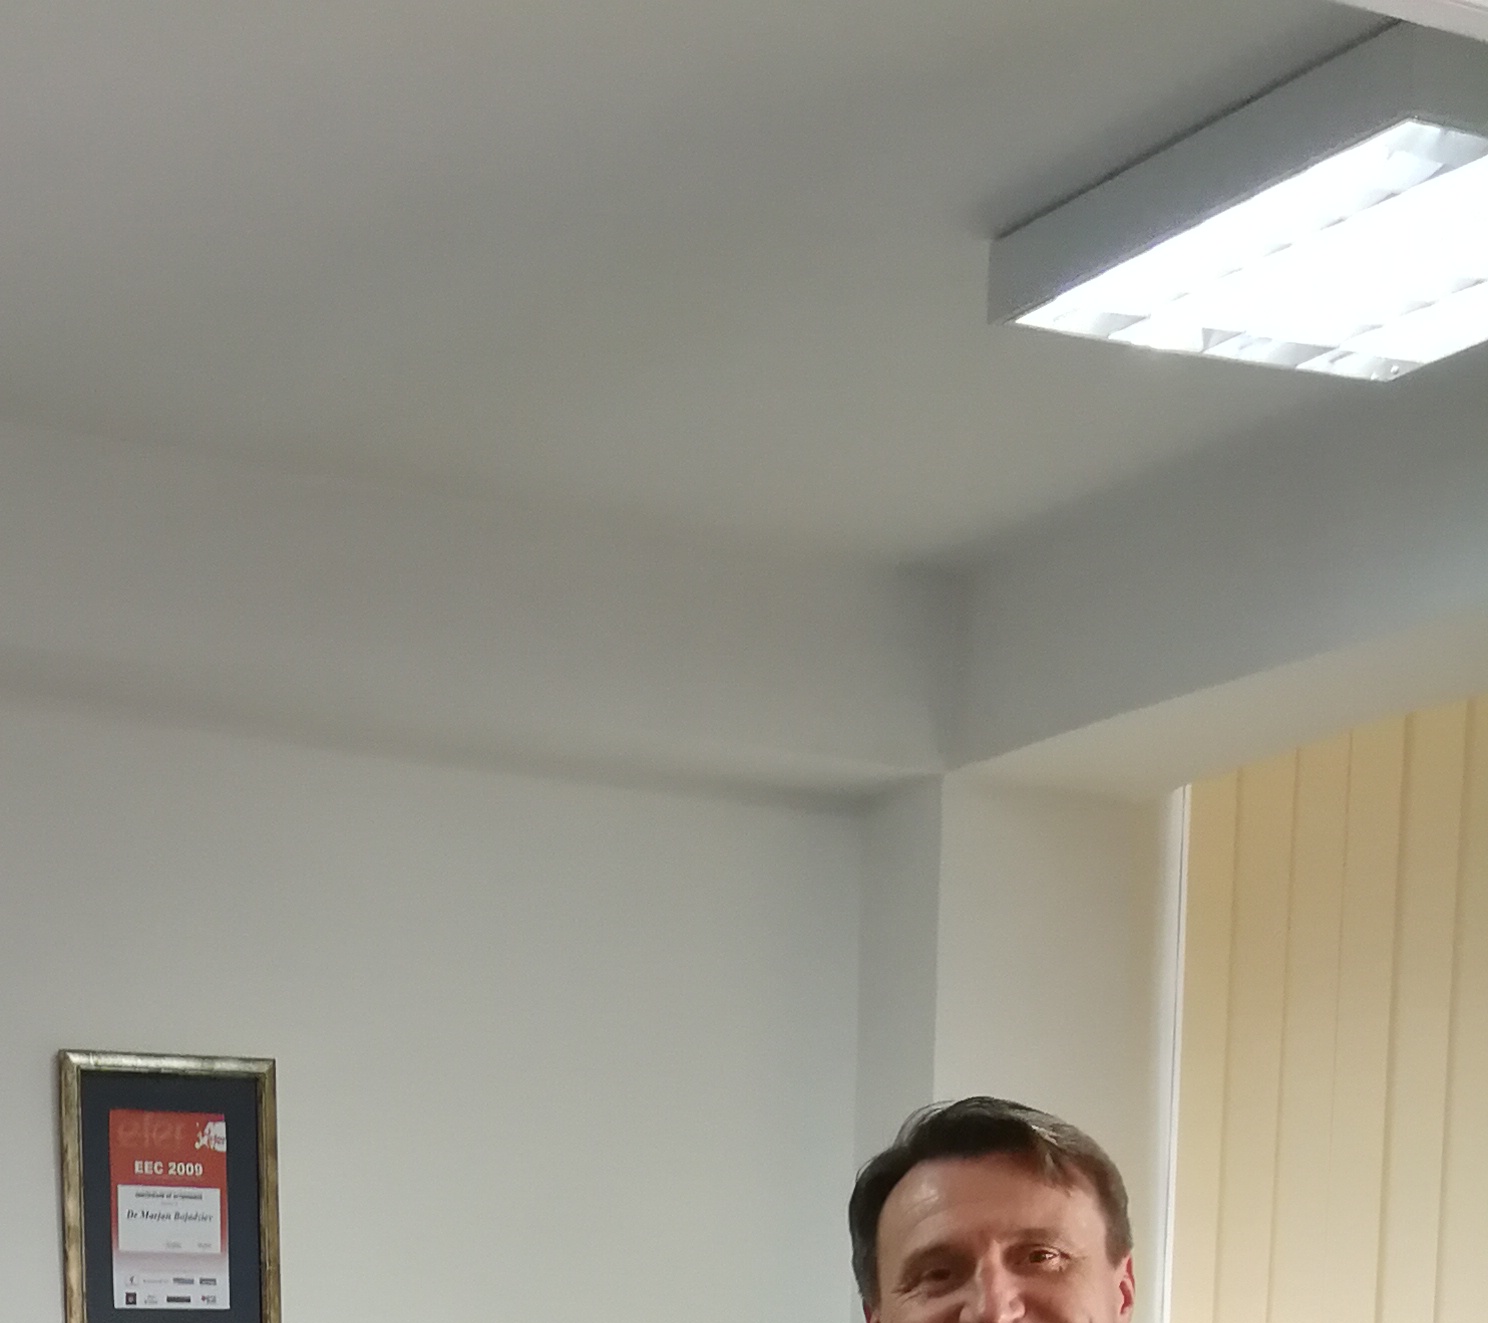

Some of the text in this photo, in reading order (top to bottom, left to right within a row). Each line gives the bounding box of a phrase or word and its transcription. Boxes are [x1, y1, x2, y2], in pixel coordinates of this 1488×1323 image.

[134, 1160, 203, 1177] EEC 2009
[140, 1210, 172, 1222] Marjan
